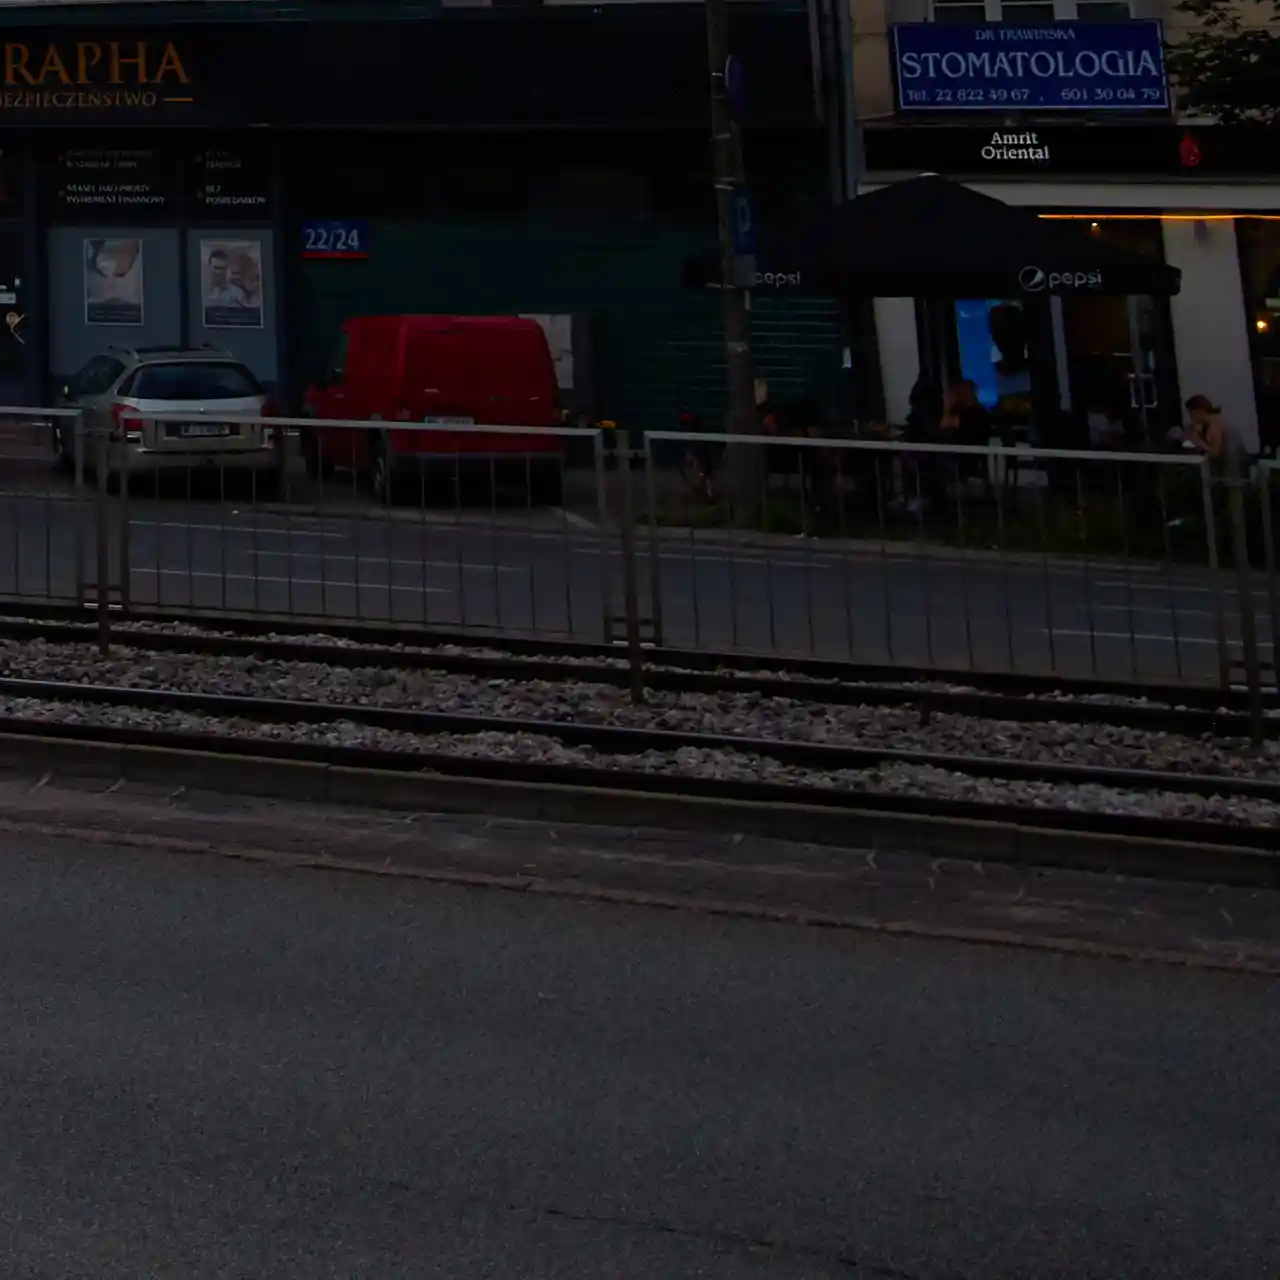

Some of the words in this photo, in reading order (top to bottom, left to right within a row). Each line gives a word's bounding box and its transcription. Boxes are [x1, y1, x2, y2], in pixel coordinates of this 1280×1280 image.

[901, 49, 1160, 79] STOMATOLOGIA
[935, 90, 953, 102] 22
[956, 89, 985, 102] 822
[1011, 89, 1031, 101] 67
[991, 132, 1039, 145] Amrit
[981, 146, 1050, 160] Oriental
[305, 227, 360, 251] 22/24
[1048, 268, 1102, 288] pepsi
